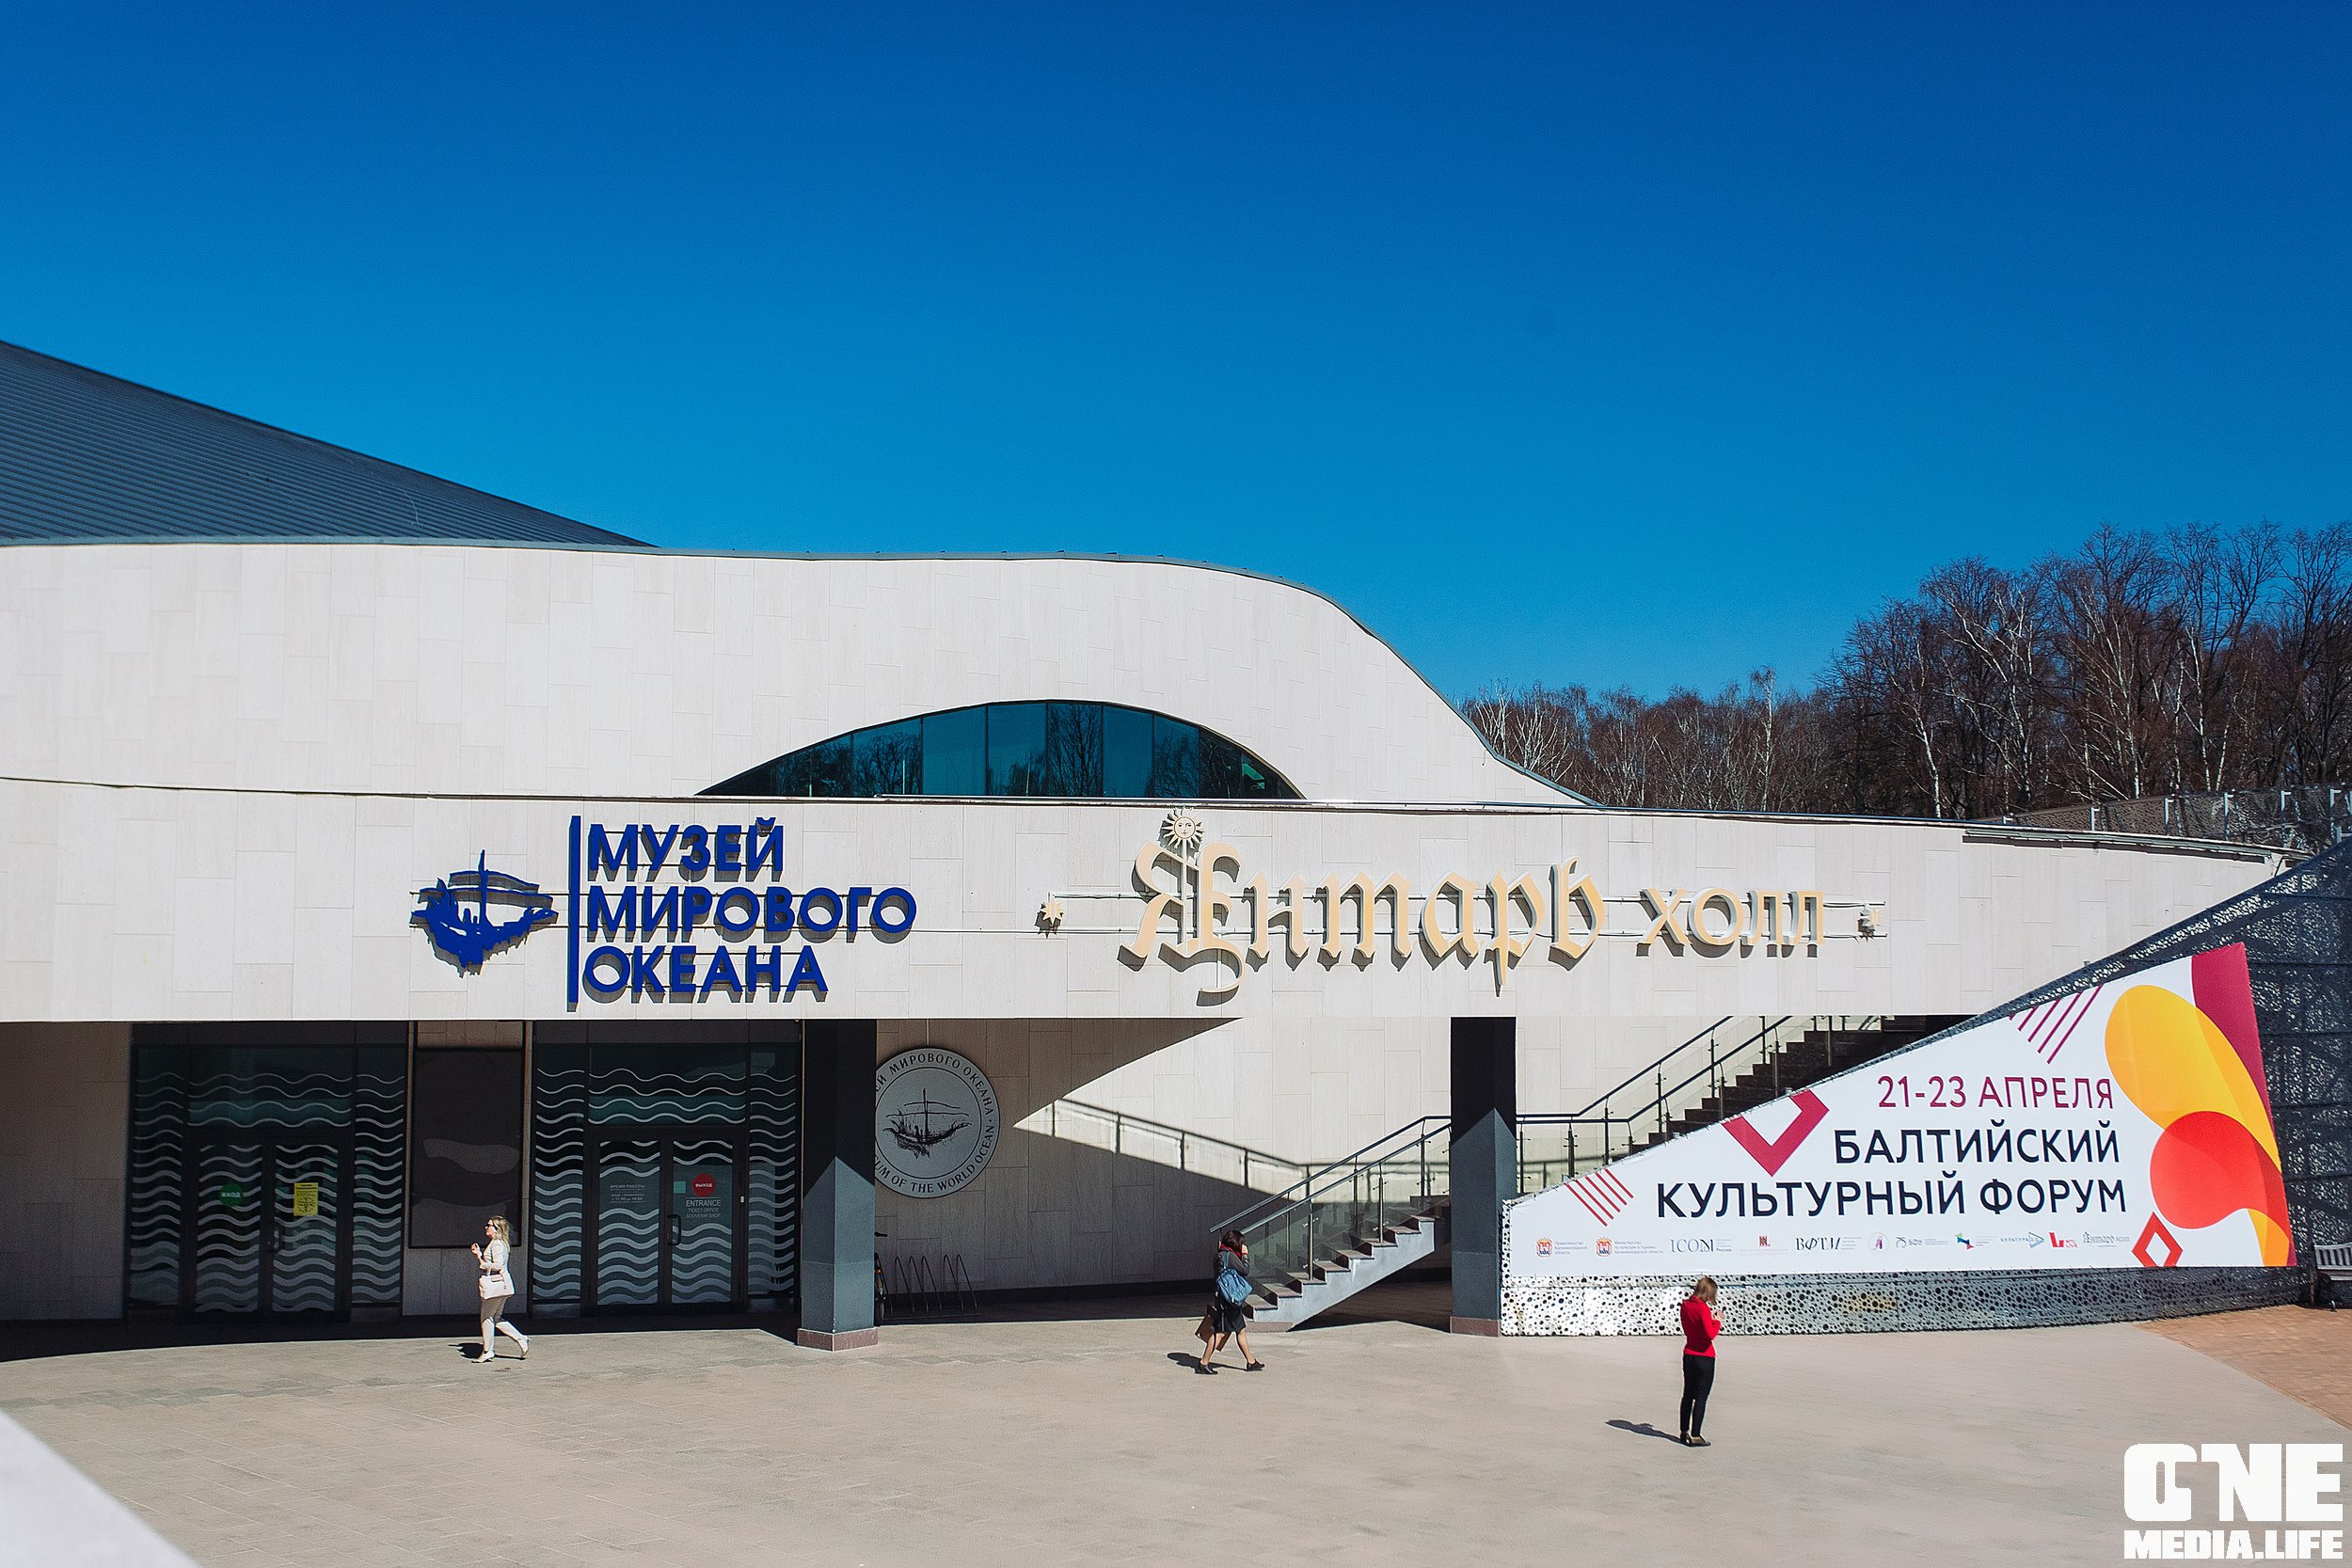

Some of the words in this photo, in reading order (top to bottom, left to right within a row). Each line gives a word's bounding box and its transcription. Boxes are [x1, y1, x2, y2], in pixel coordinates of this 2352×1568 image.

[588, 817, 784, 873] МУЗЕЙ
[588, 886, 917, 934] МИРОВОГО
[584, 944, 829, 995] ОКЕАНА
[889, 1053, 961, 1075] МИРОВОГО
[962, 1067, 994, 1116] ОКЕАНА
[1878, 1076, 1967, 1108] 21-23
[1979, 1076, 2114, 1109] АПРЕЛЯ
[891, 1176, 908, 1187] OF
[911, 1182, 934, 1193] THE
[936, 1164, 977, 1191] WORLD
[974, 1125, 994, 1164] OCEAN
[1835, 1119, 2120, 1164] БАЛТИЙСКИЙ
[1656, 1170, 1965, 1217] КУЛЬТУРНЫЙ
[1979, 1178, 2126, 1214] ФОРУМ
